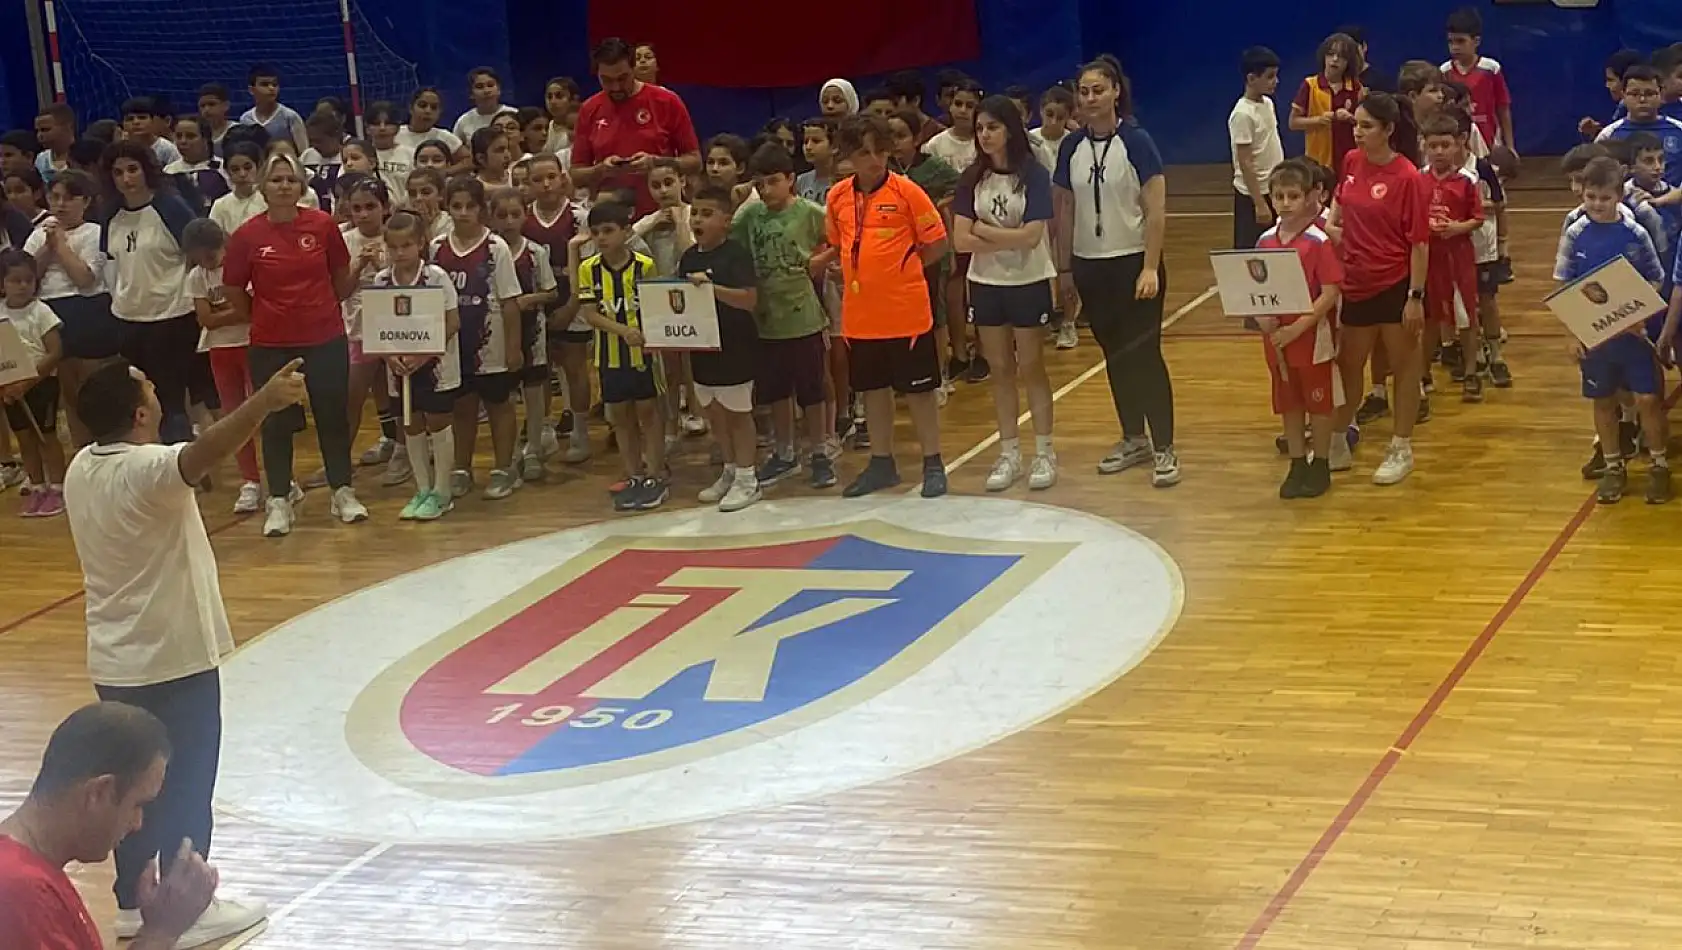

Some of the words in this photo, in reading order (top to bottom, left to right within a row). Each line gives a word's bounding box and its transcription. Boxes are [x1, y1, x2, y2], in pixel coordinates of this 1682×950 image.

[379, 330, 431, 341] BORNOVA
[664, 325, 698, 338] BUCA
[485, 702, 674, 730] 1950
